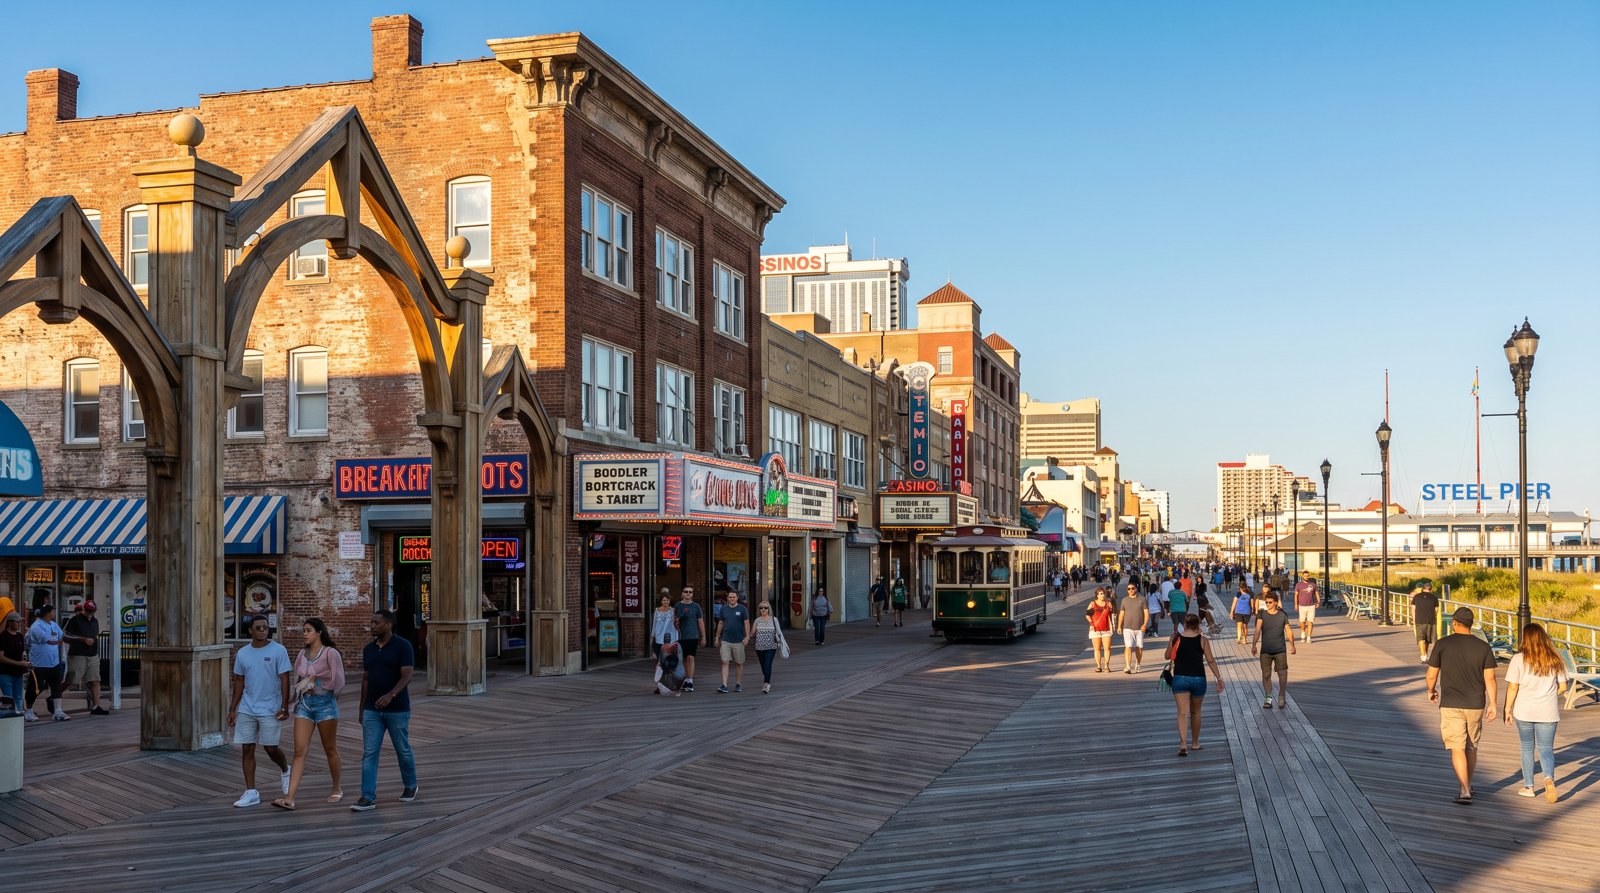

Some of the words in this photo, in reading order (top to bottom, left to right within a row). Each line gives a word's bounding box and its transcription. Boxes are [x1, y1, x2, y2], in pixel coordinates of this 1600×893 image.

[594, 467, 648, 478] BOODLER
[585, 480, 656, 492] BORTCRACK
[1422, 483, 1493, 501] STEEL
[1499, 482, 1551, 500] PIER
[60, 546, 98, 555] ATLANTIC
[99, 546, 118, 555] CITY
